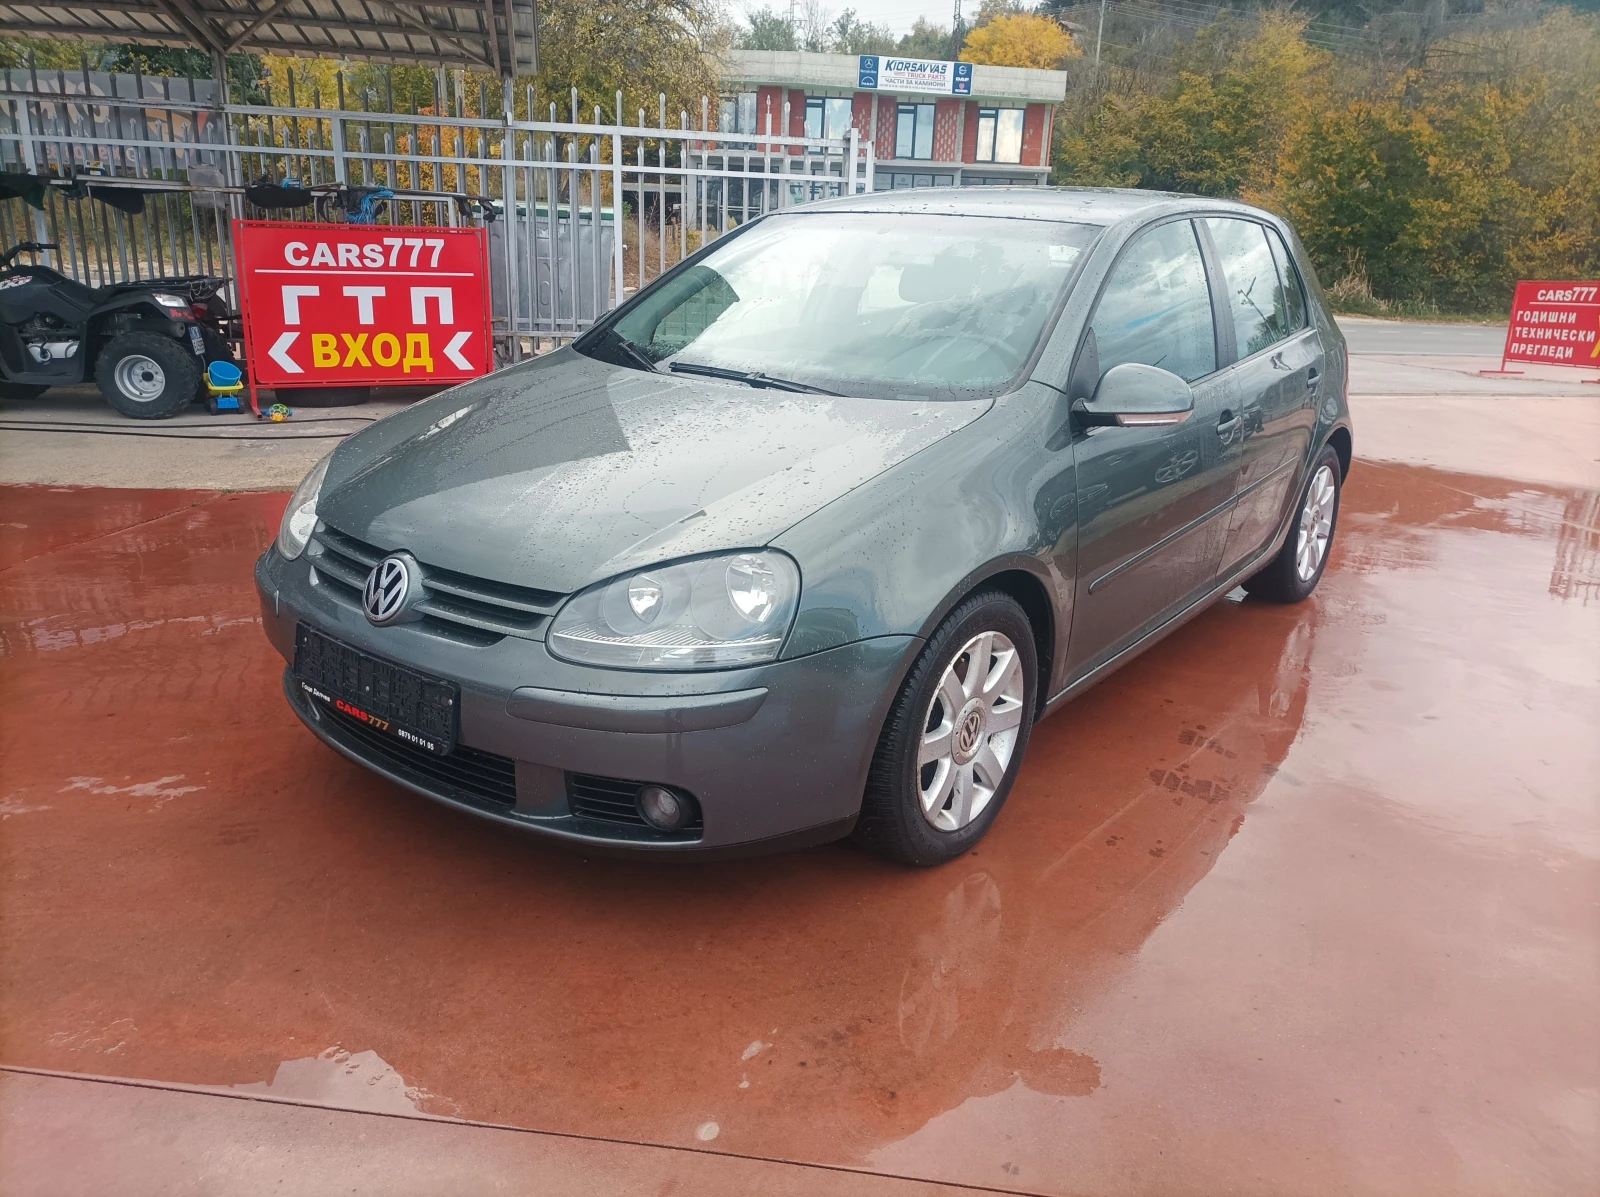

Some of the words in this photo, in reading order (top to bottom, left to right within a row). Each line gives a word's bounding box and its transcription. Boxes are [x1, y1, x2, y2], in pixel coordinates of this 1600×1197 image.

[885, 60, 948, 74] KIORSAVVAS
[284, 237, 445, 268] CARS777
[1537, 287, 1598, 302] CARS777
[1516, 310, 1577, 324] ГОДИШНИ
[1515, 327, 1596, 342] ТЕХНИЧЕСКИ
[311, 332, 434, 374] ВХОД
[1511, 343, 1574, 359] ПРЕГЛЕДИ
[336, 699, 389, 731] CARS777
[411, 734, 418, 744] 01
[419, 738, 426, 747] 01
